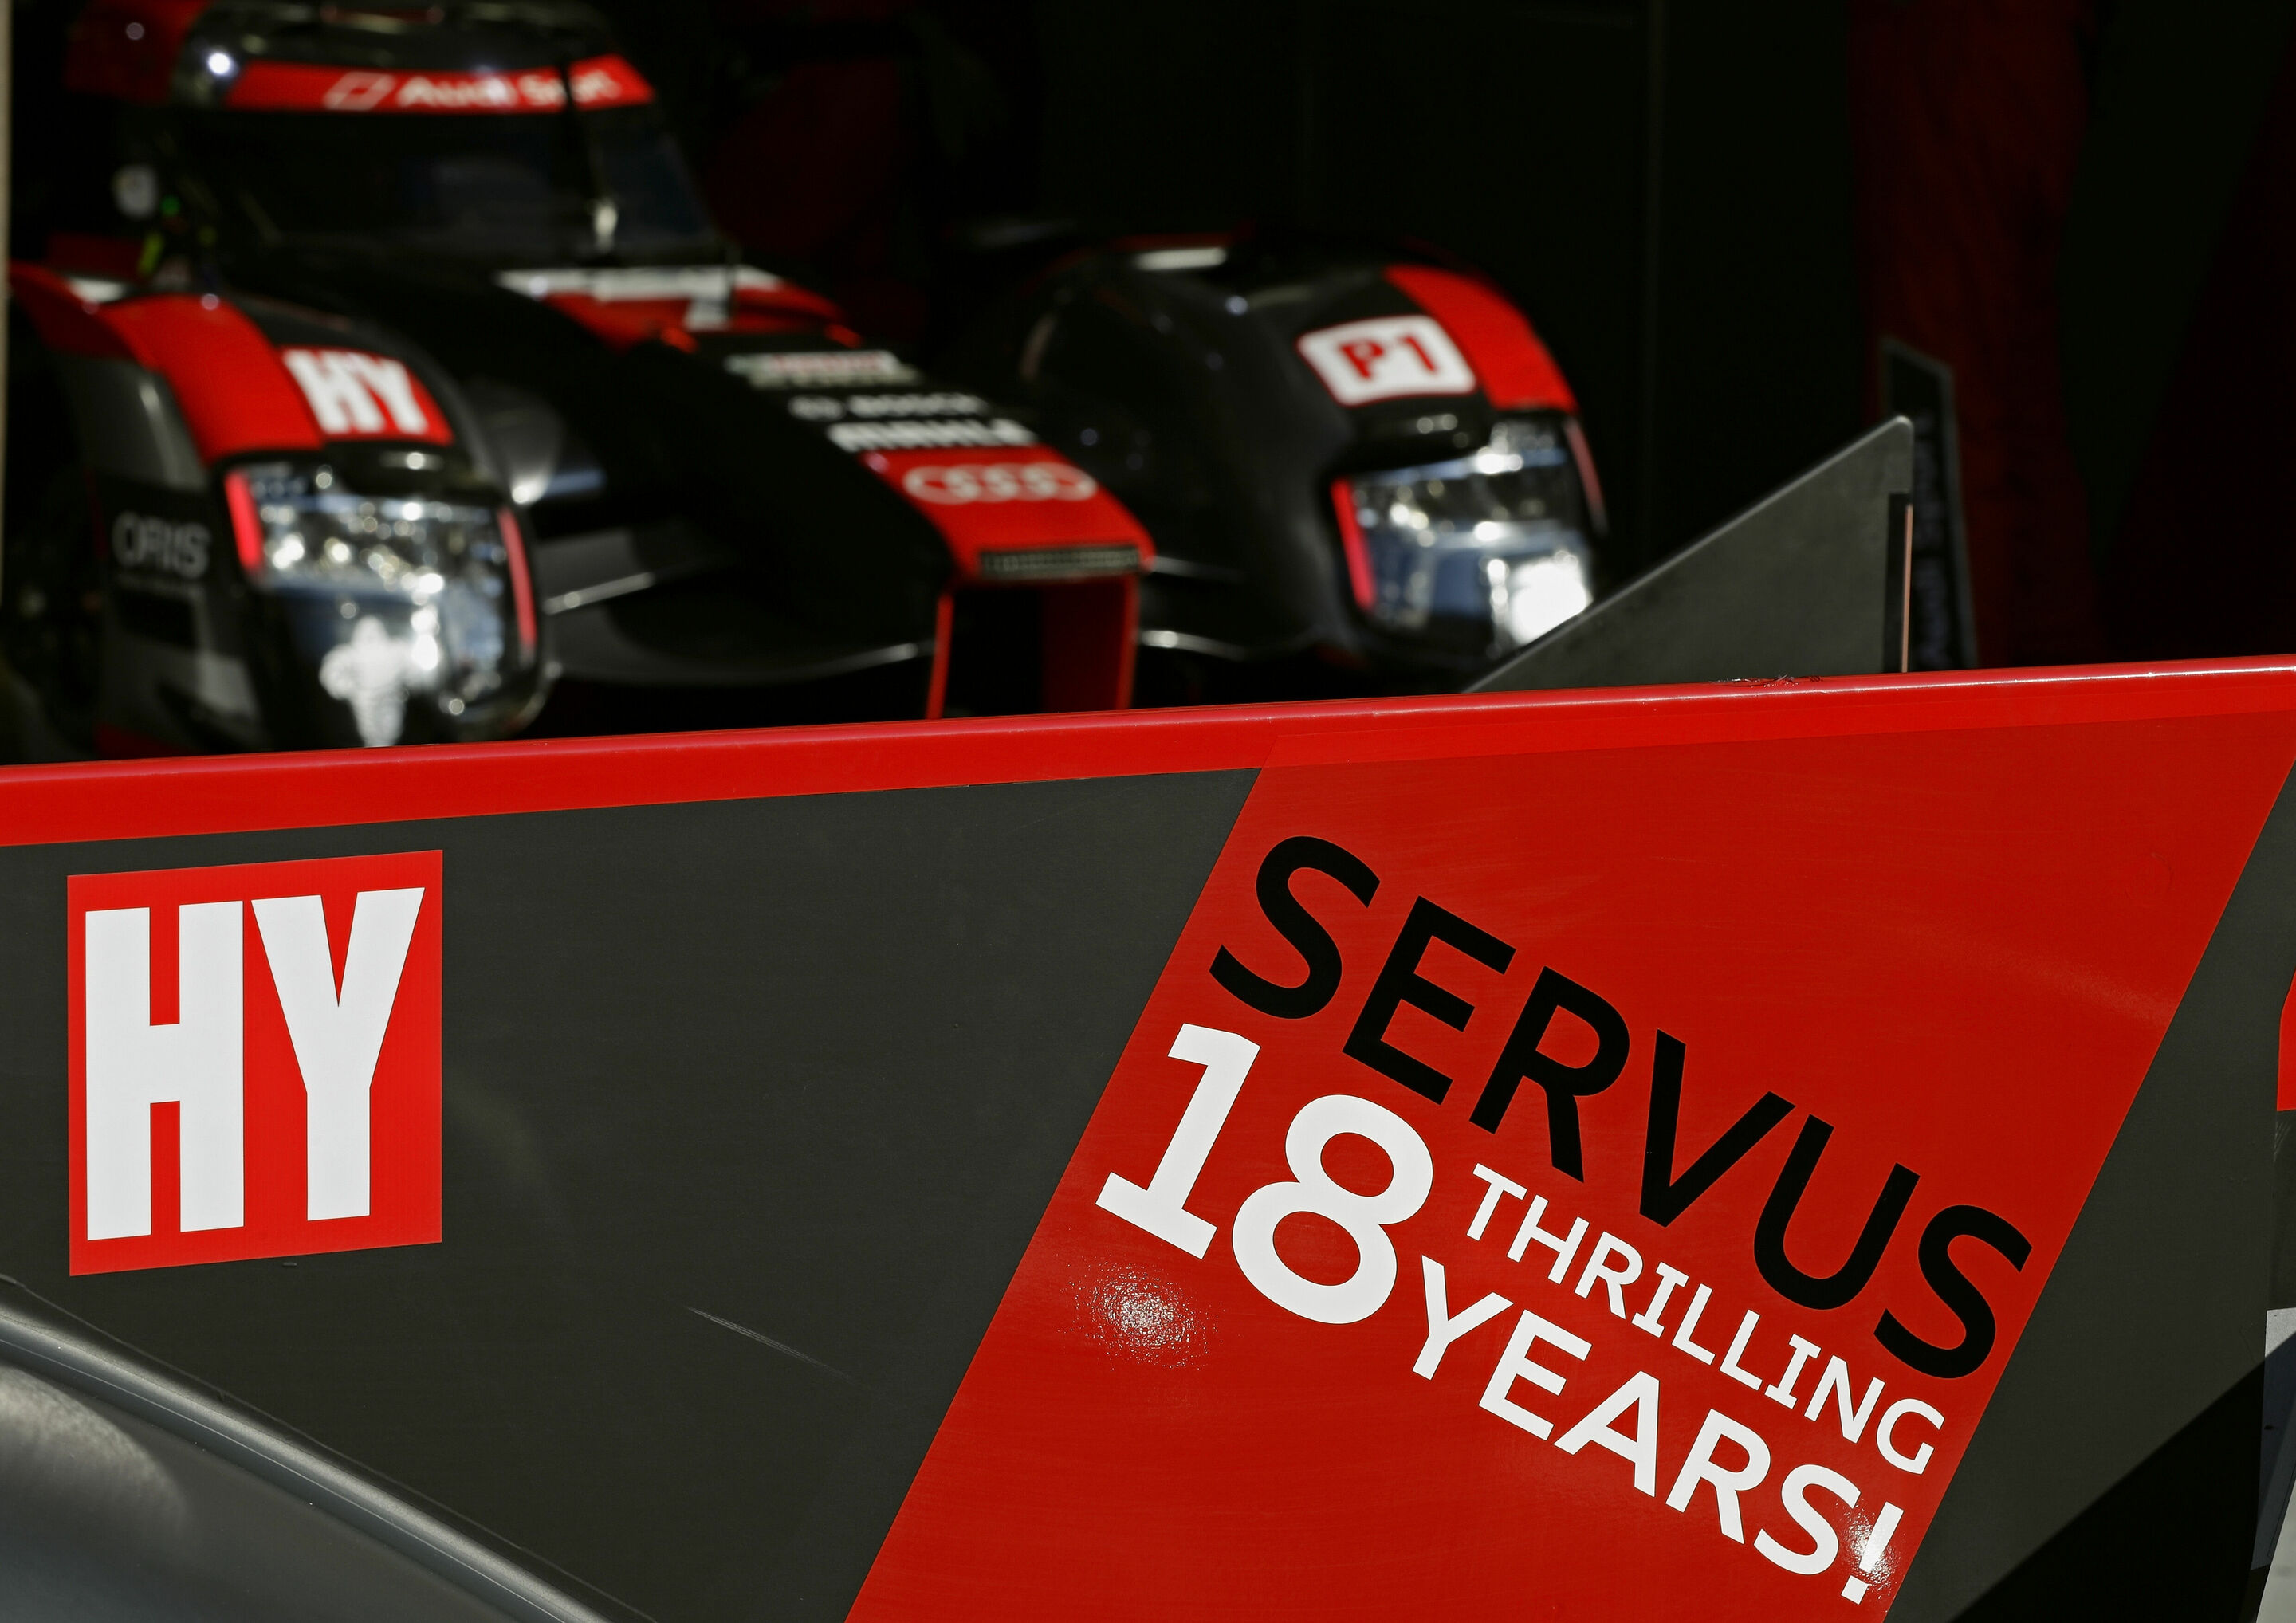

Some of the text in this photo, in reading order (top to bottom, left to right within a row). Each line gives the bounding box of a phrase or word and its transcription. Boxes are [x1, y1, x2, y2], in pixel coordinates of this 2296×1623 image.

[281, 348, 429, 435] HY
[1339, 330, 1441, 381] P1
[85, 886, 426, 1241] HY
[1095, 1023, 1433, 1324] 18
[1209, 836, 2031, 1378] SERVUS
[1413, 1255, 1905, 1605] YEARS!
[1467, 1162, 1944, 1475] THRILLING
